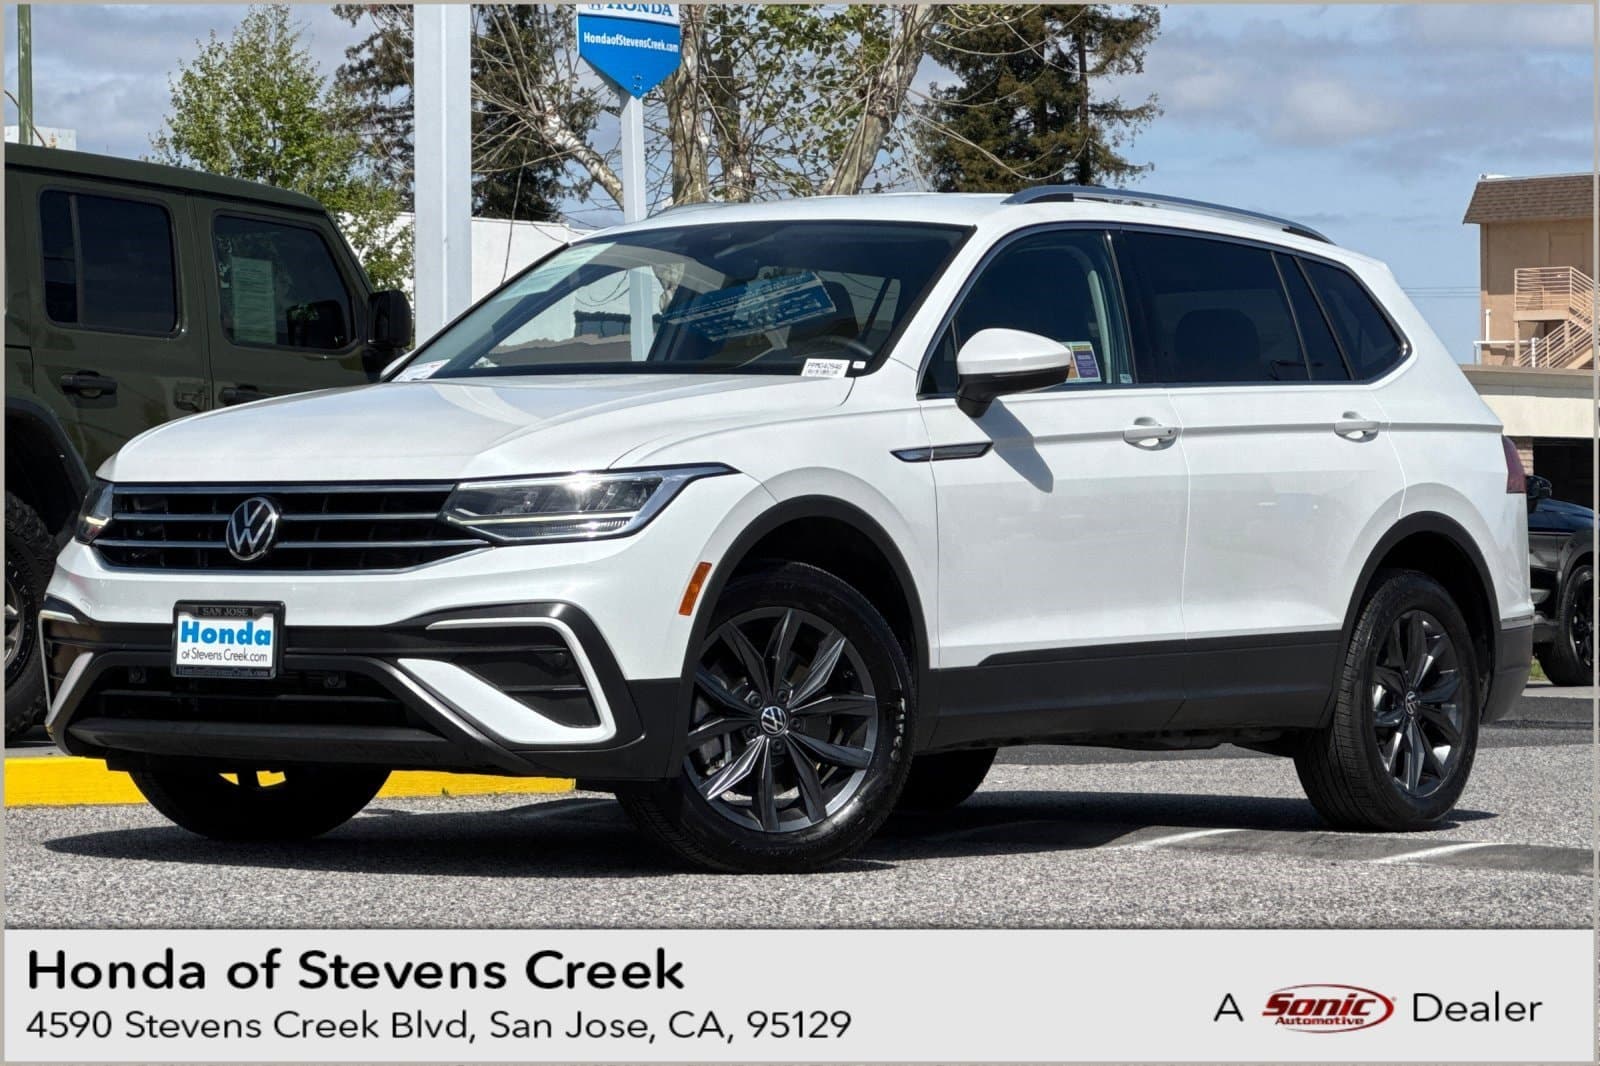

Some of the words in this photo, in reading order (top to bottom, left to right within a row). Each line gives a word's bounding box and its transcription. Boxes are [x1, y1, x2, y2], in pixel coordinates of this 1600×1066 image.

[583, 31, 679, 53] HondaofStevensCreek.com
[203, 608, 222, 616] SAN
[224, 608, 249, 617] JOSE
[181, 620, 271, 646] Honda
[181, 649, 190, 660] of
[191, 647, 222, 661] Stevens
[224, 648, 268, 663] Creek.com
